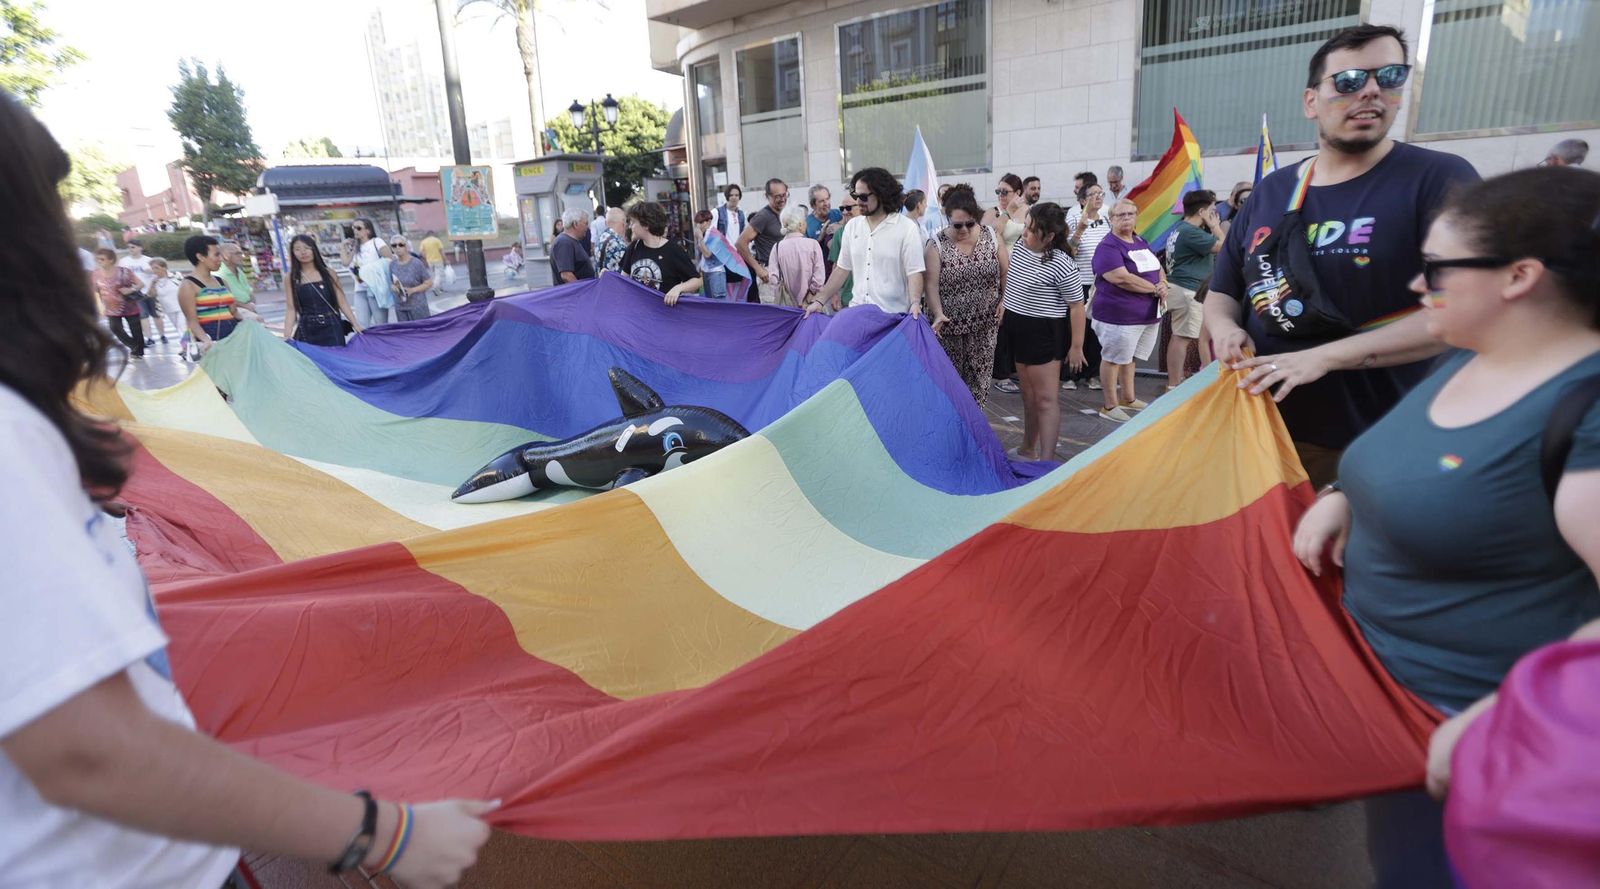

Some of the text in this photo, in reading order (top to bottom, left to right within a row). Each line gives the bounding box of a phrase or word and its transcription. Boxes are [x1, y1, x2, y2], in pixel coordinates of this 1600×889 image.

[523, 164, 542, 175] ONCE
[575, 163, 592, 172] ONCE
[1248, 217, 1376, 254] PIDE
[1330, 247, 1369, 255] COLOR
[1257, 254, 1275, 287] LOVE
[1270, 300, 1295, 333] LOVE
